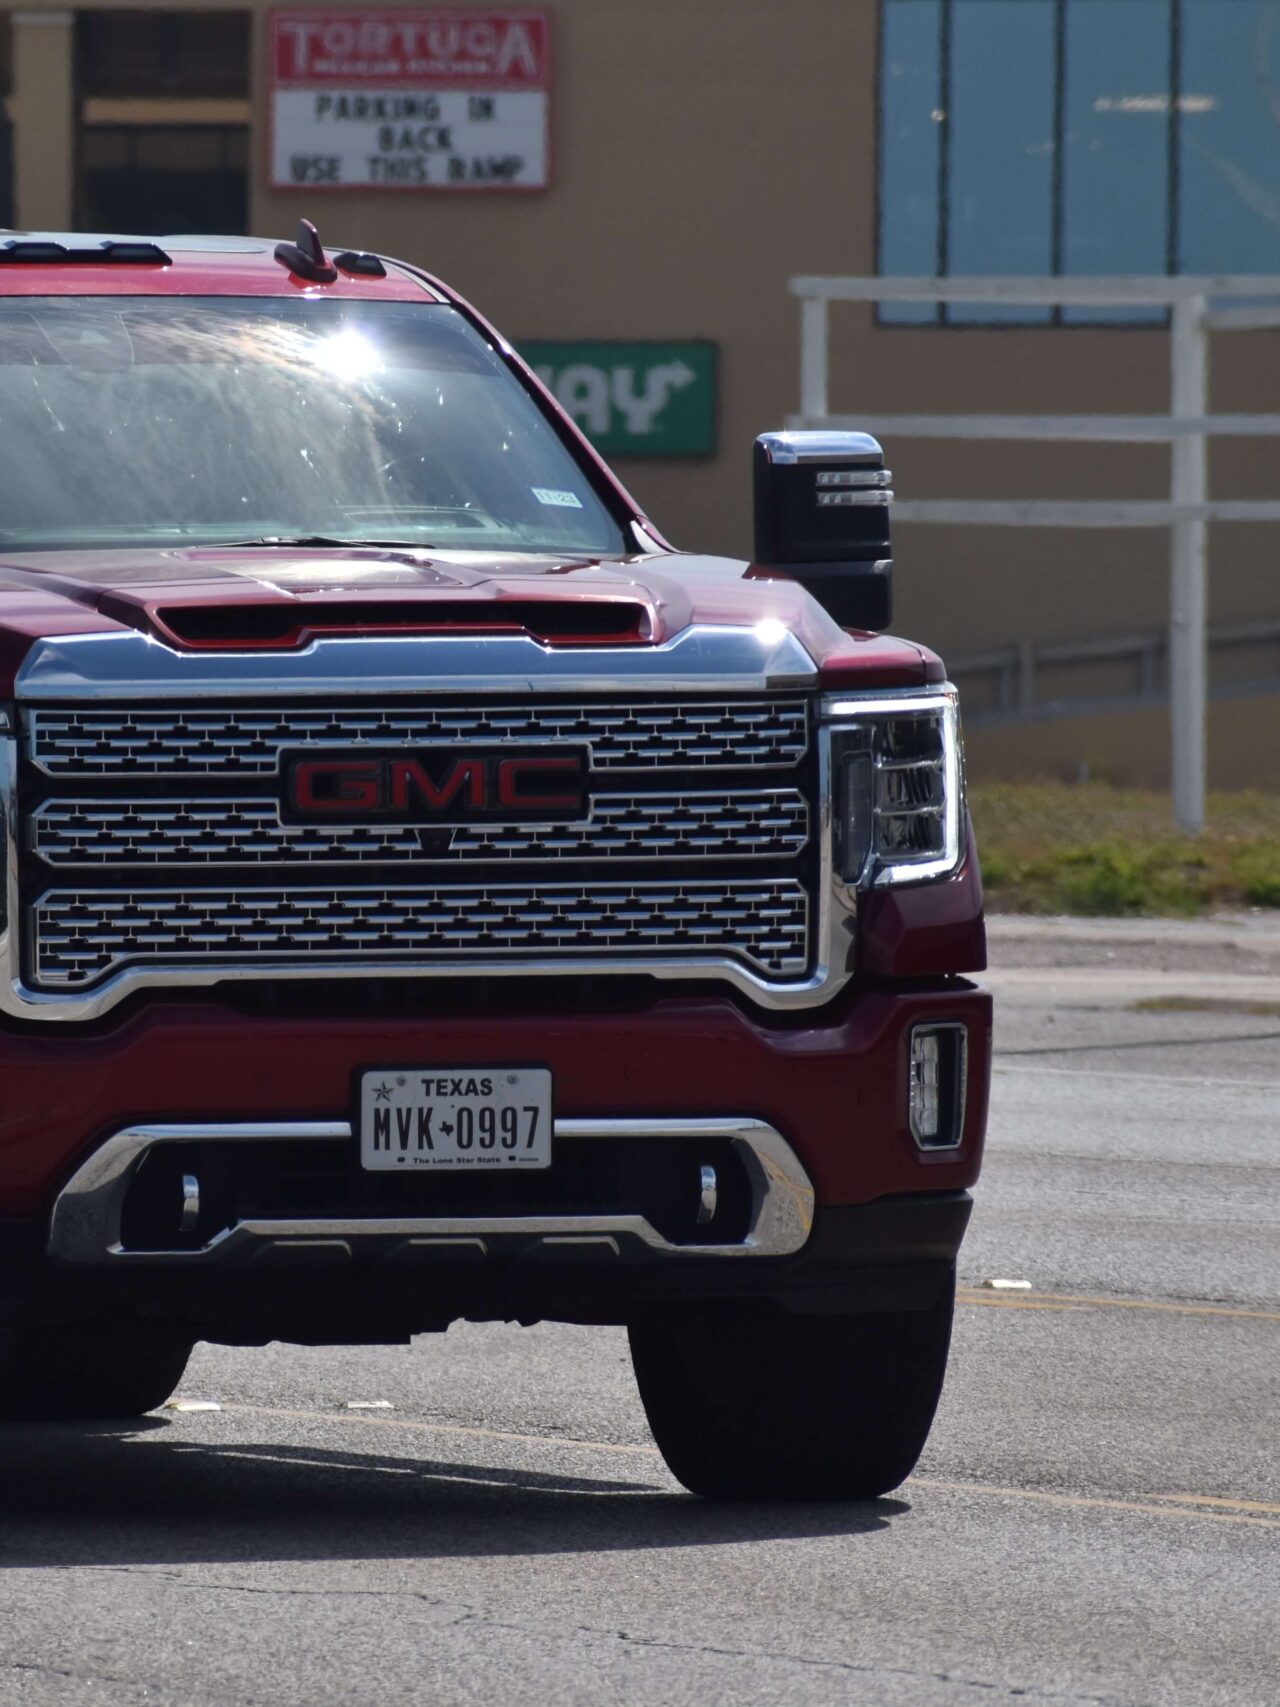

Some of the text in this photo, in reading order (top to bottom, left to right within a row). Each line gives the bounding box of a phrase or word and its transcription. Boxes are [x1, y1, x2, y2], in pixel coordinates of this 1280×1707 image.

[278, 21, 537, 77] TORTUGA
[315, 95, 495, 121] PARKING IN
[378, 126, 452, 152] BACK
[289, 154, 525, 183] USE THIS RAMP
[295, 758, 580, 810] GMC
[421, 1078, 493, 1097] TEXAS
[373, 1106, 539, 1150] MVK 0997
